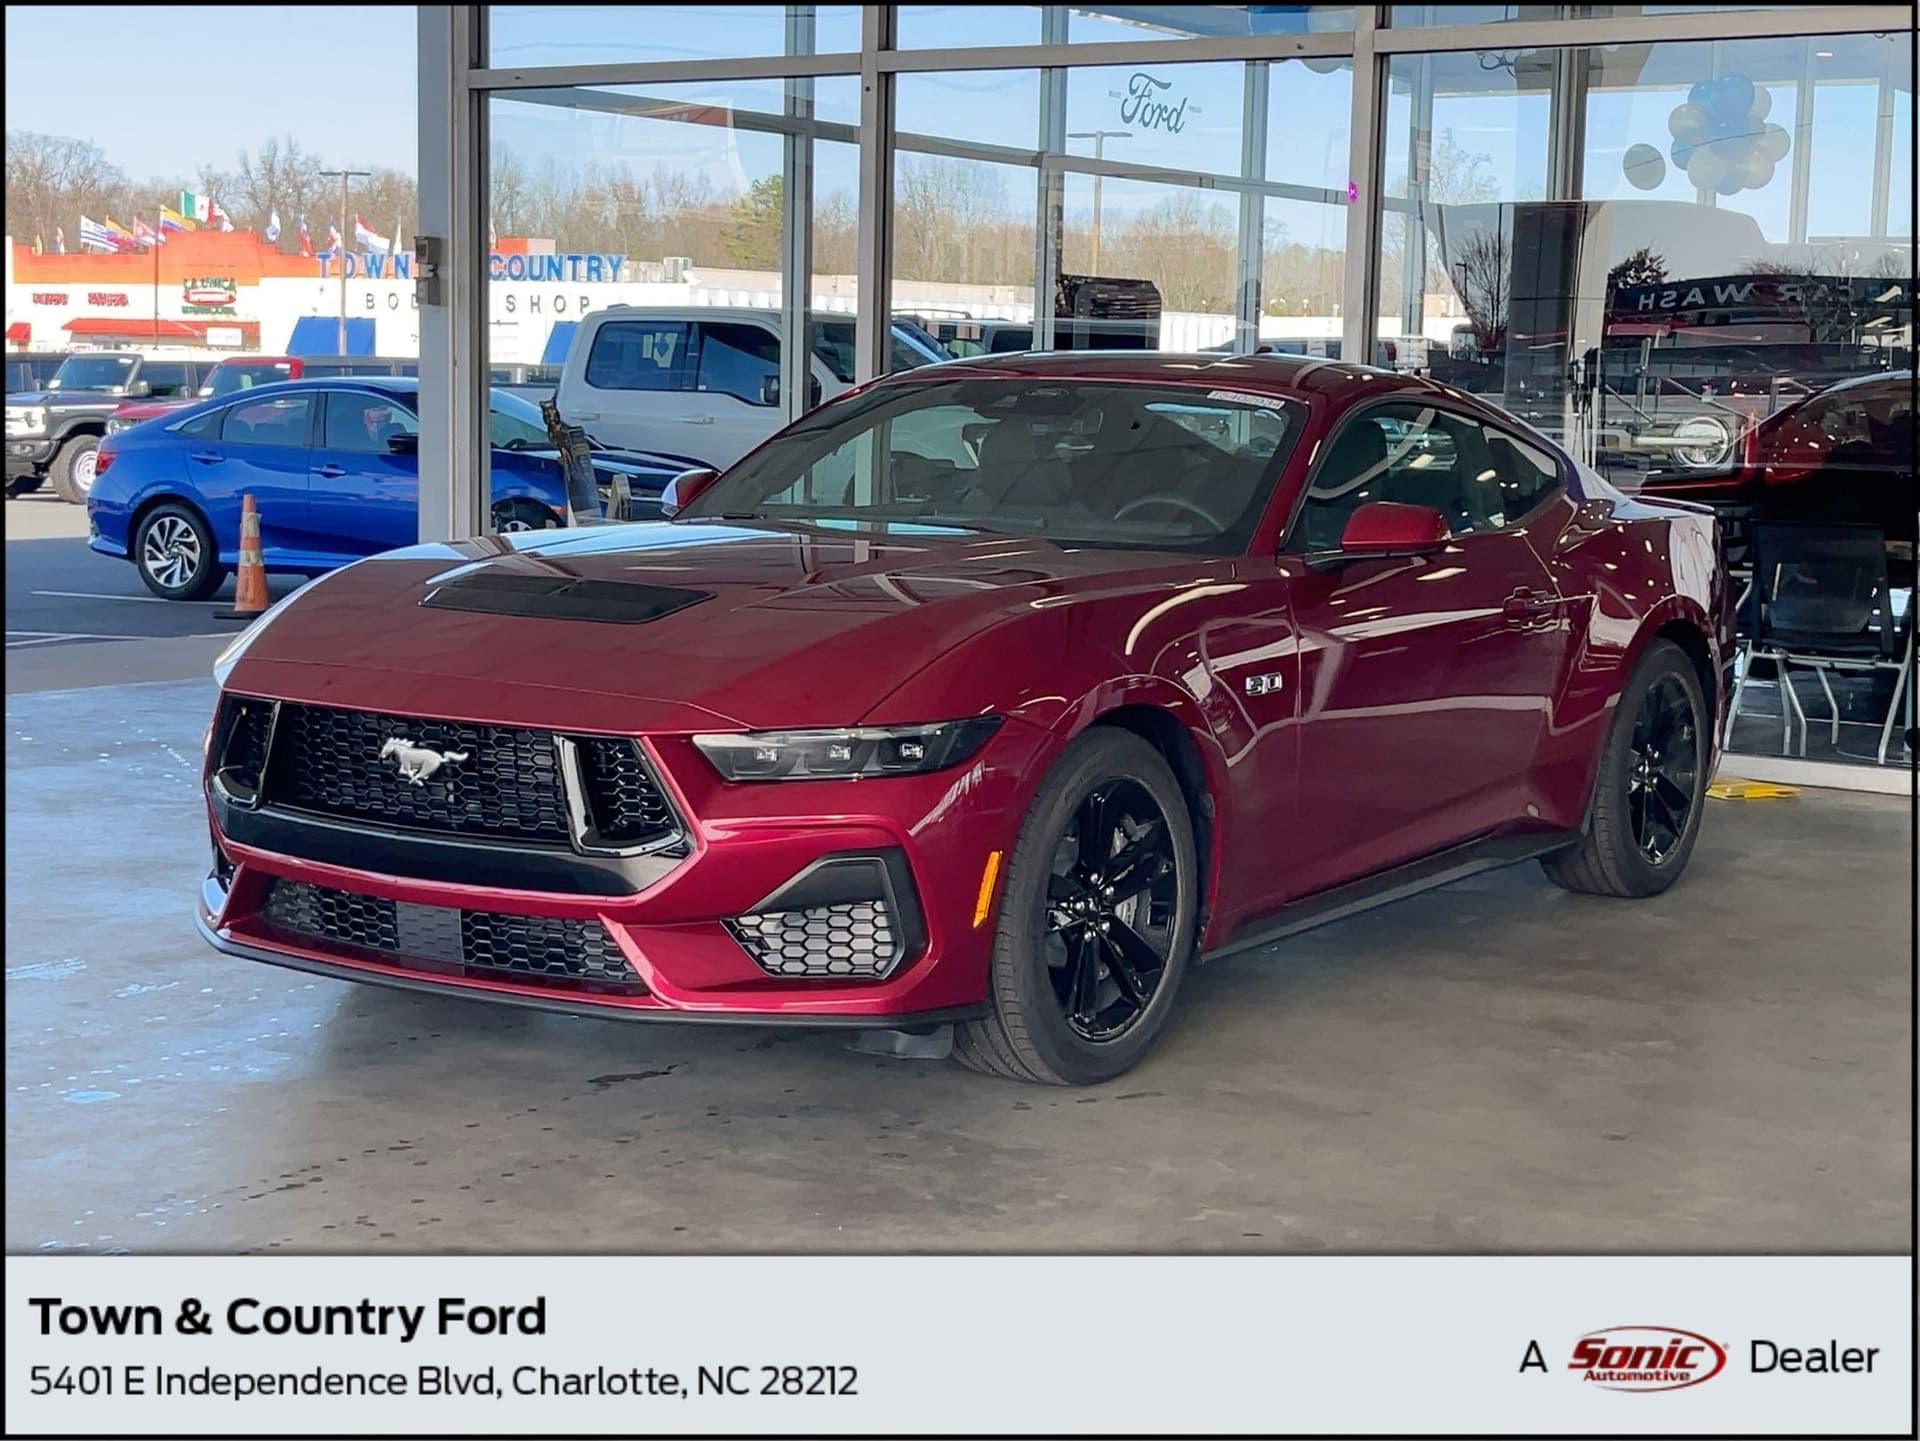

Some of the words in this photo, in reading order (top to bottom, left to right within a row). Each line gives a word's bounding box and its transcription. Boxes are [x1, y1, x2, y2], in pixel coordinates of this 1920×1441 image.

[1121, 72, 1187, 133] Ford
[317, 252, 410, 279] TOWN
[488, 254, 622, 281] COUNTRY
[506, 294, 590, 313] SHOP
